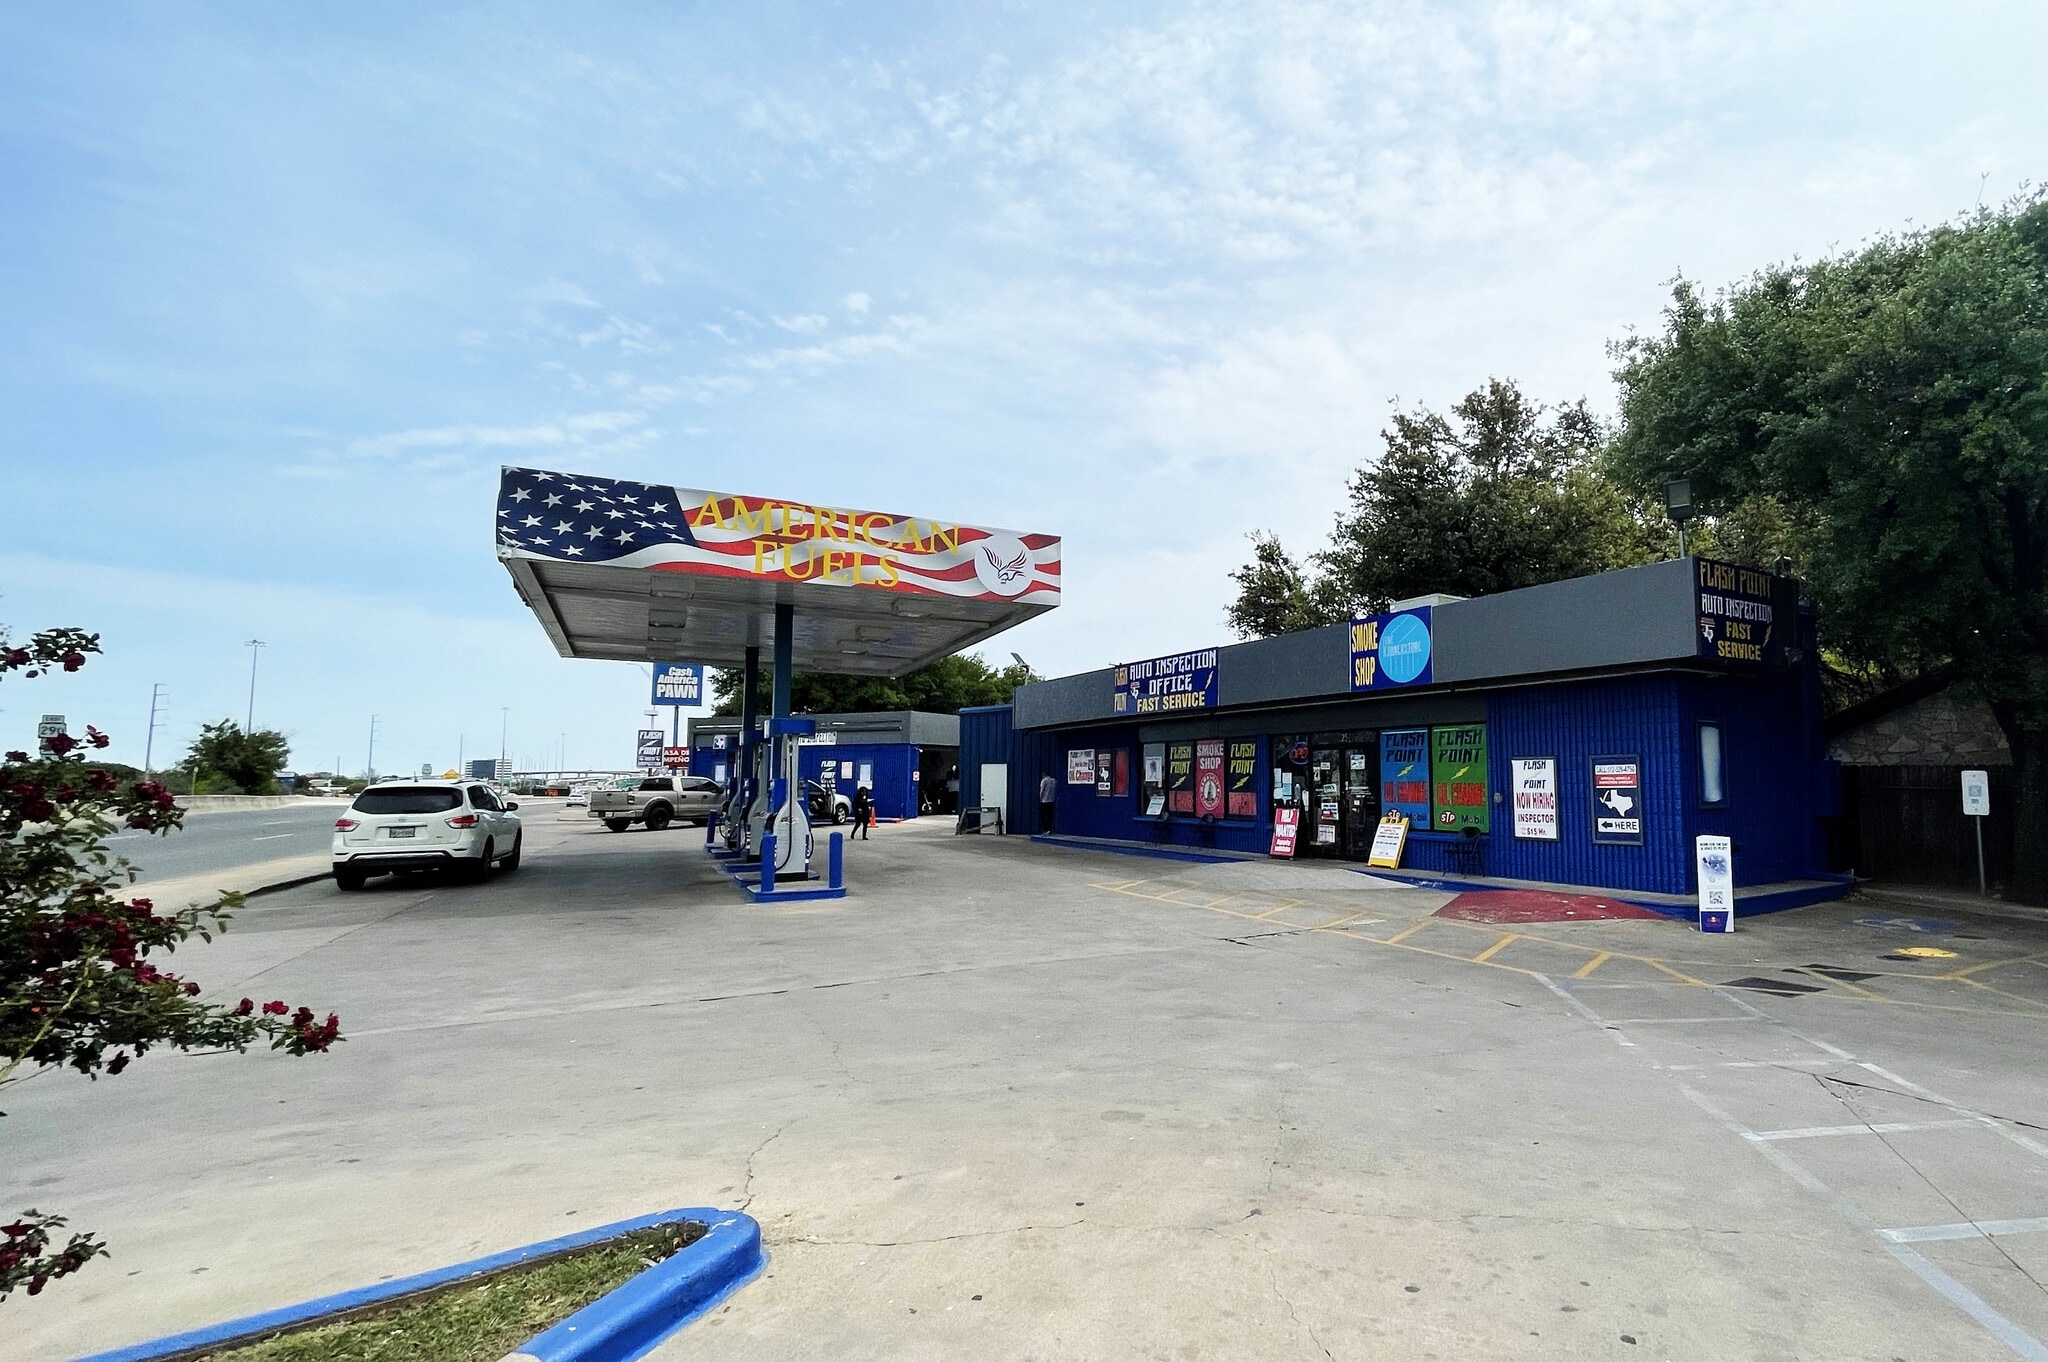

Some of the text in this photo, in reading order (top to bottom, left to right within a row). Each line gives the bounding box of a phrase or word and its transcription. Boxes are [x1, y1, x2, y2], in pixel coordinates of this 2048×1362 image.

[690, 494, 960, 555] AMERICAN
[752, 539, 899, 588] FUELS
[1700, 561, 1771, 599] FLASH POINT
[1701, 593, 1772, 623] AUTO INSPECTION
[1351, 621, 1378, 653] SMOKE
[1726, 621, 1751, 640] FAST
[1717, 640, 1761, 661] SERVICE
[668, 667, 693, 676] Cash
[1129, 649, 1217, 681] AUTO INSPECTION
[1355, 656, 1376, 687] SHOP
[657, 674, 698, 684] America
[1148, 673, 1193, 695] OFFICE
[656, 684, 698, 698] PAWN
[1137, 690, 1206, 712] FAST SERVICE
[40, 726, 64, 735] 290
[639, 731, 663, 740] FLASH
[1438, 729, 1482, 746] FLASH
[1386, 732, 1425, 747] FLASH
[638, 746, 662, 755] POINT
[1170, 746, 1192, 760] FLASH
[1196, 744, 1224, 756] SMOKE
[1230, 743, 1256, 758] FLASH
[1385, 748, 1424, 763] POINT
[1439, 747, 1482, 763] POINT
[664, 755, 689, 763] MPEÑO
[1200, 757, 1221, 770] SHOP
[1523, 760, 1546, 770] FLASH
[1170, 761, 1192, 774] POINT
[1230, 760, 1256, 775] POINT
[1523, 779, 1546, 789] POINT
[1516, 792, 1554, 810] NOW HIRING
[1405, 811, 1427, 821] Mobil
[1441, 811, 1485, 825] STP Mobil
[1518, 814, 1555, 824] INSPECTOR
[1615, 821, 1638, 830] HERE
